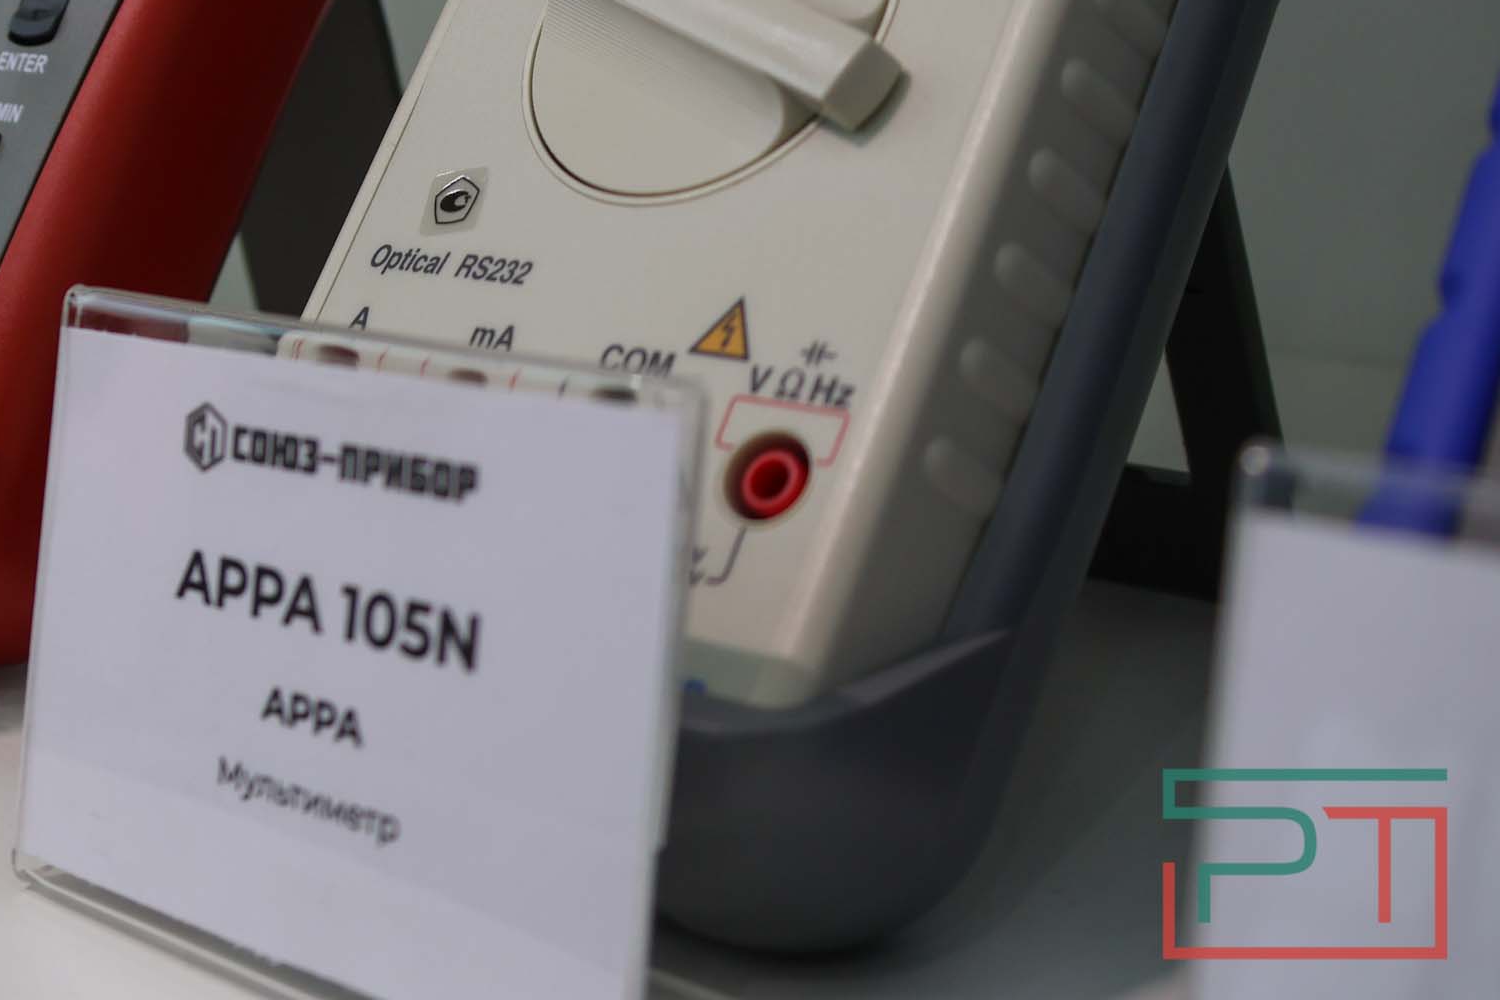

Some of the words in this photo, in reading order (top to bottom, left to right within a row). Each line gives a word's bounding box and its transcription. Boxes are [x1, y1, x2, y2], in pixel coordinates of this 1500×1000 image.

[370, 243, 451, 276] Optical
[454, 253, 534, 286] RS232
[348, 306, 370, 331] A
[468, 324, 515, 352] mA
[599, 343, 676, 377] COM
[749, 364, 773, 394] V
[807, 374, 855, 406] Hz
[231, 424, 480, 504] СОЮЗ-ПРИБОР
[175, 549, 323, 635] APPA
[341, 585, 481, 673] 105N
[261, 686, 364, 748] APPA
[216, 756, 401, 846] Мультиметр
